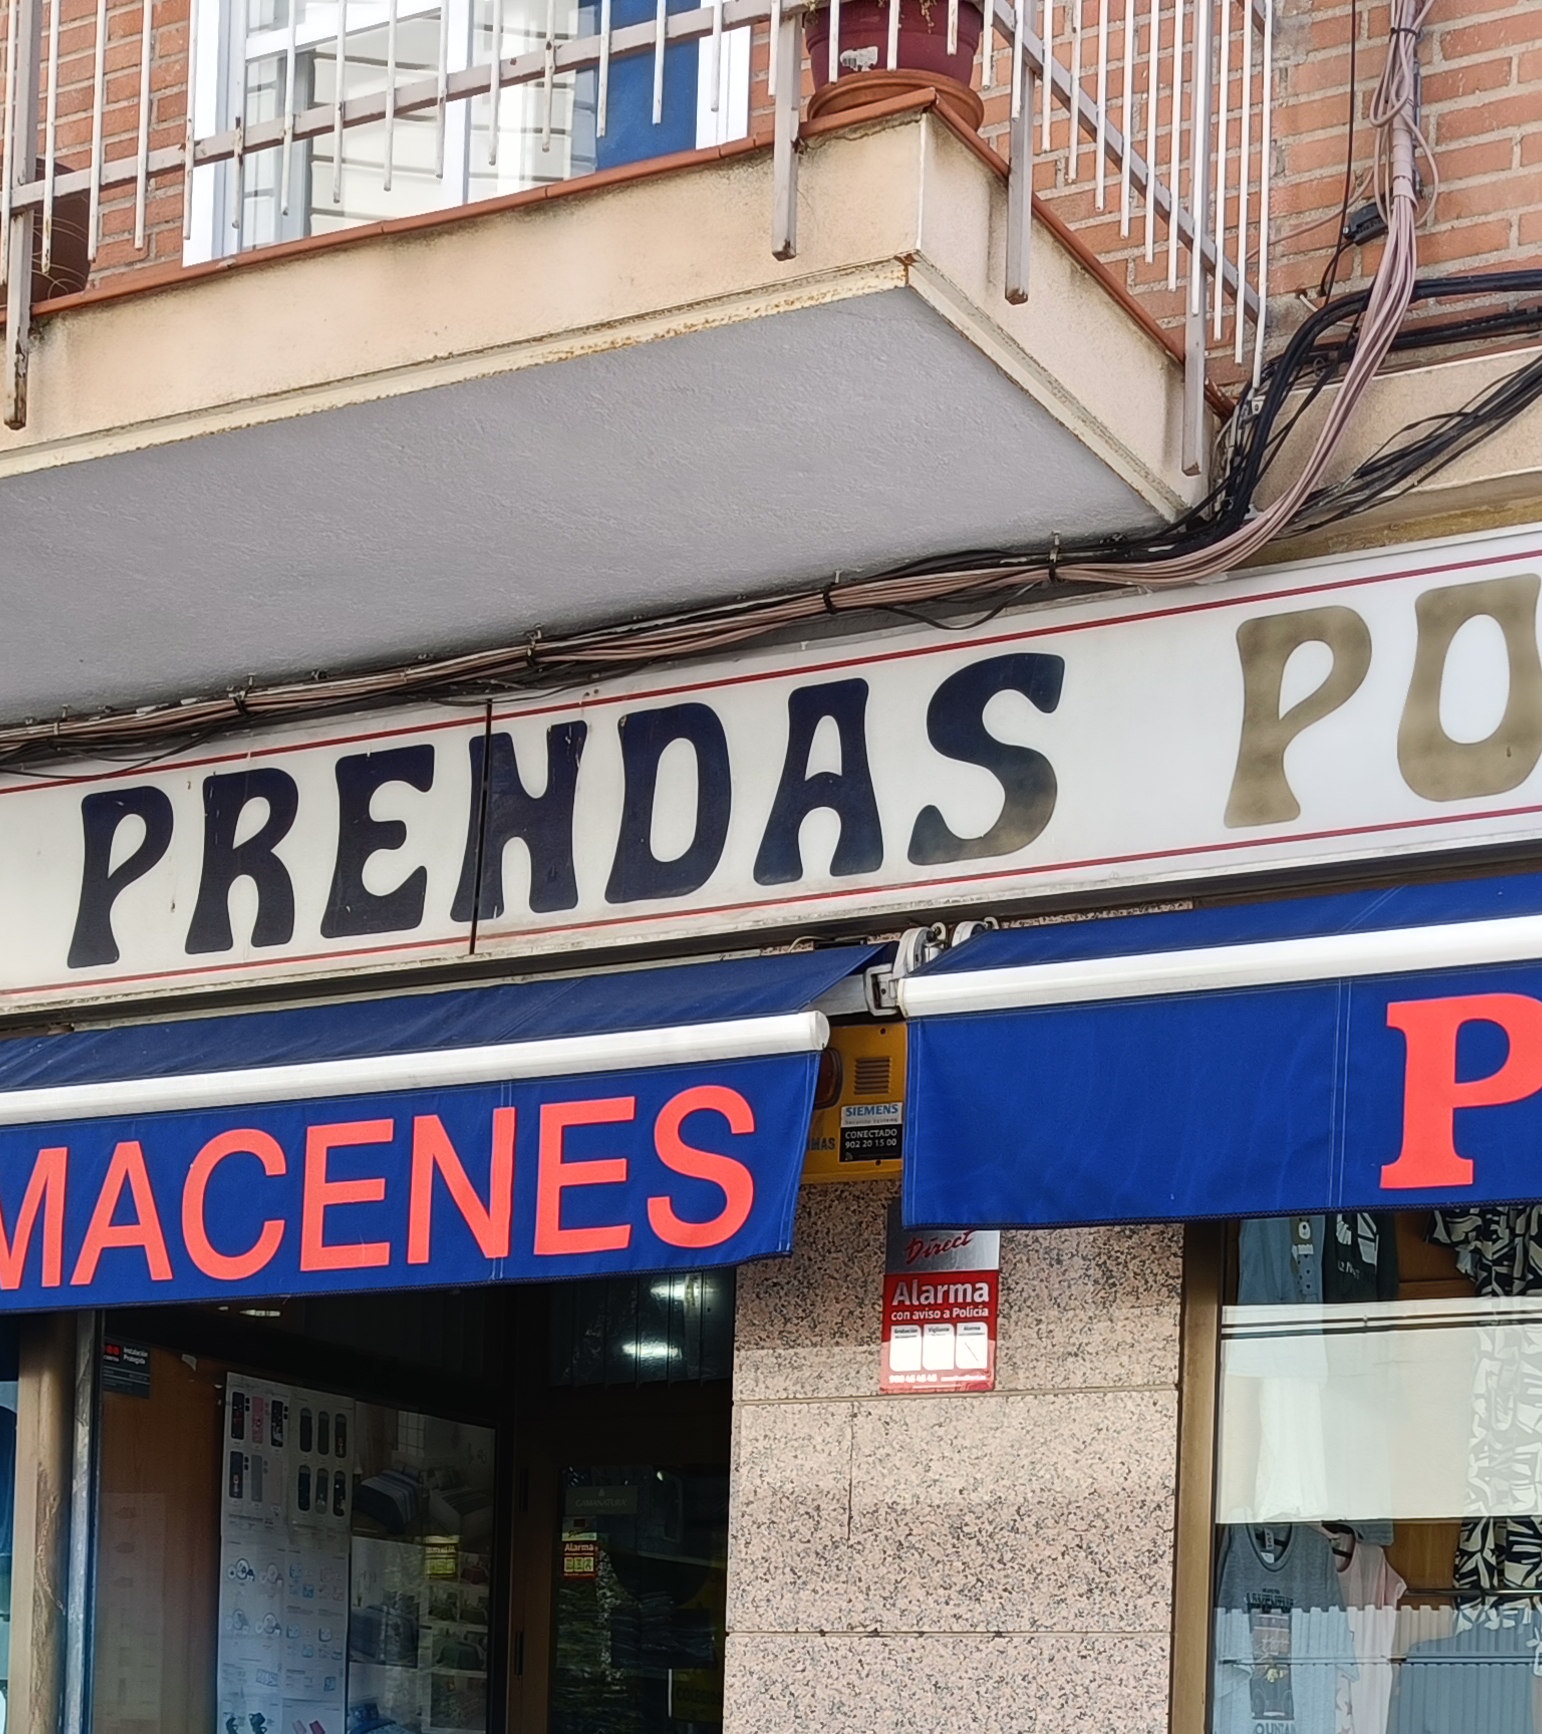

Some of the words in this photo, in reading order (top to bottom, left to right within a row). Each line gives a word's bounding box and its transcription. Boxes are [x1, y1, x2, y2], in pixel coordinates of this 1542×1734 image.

[68, 652, 1063, 966] PRENDAS
[845, 1104, 899, 1117] SIEMENS
[845, 1129, 897, 1139] CONECTADO
[845, 1141, 860, 1149] 902
[875, 1139, 885, 1147] 15
[886, 1138, 897, 1146] 00
[892, 1279, 989, 1306] Alarma
[891, 1311, 910, 1321] con
[912, 1307, 941, 1320] aviso
[943, 1309, 950, 1318] a
[564, 1543, 594, 1552] Alarma
